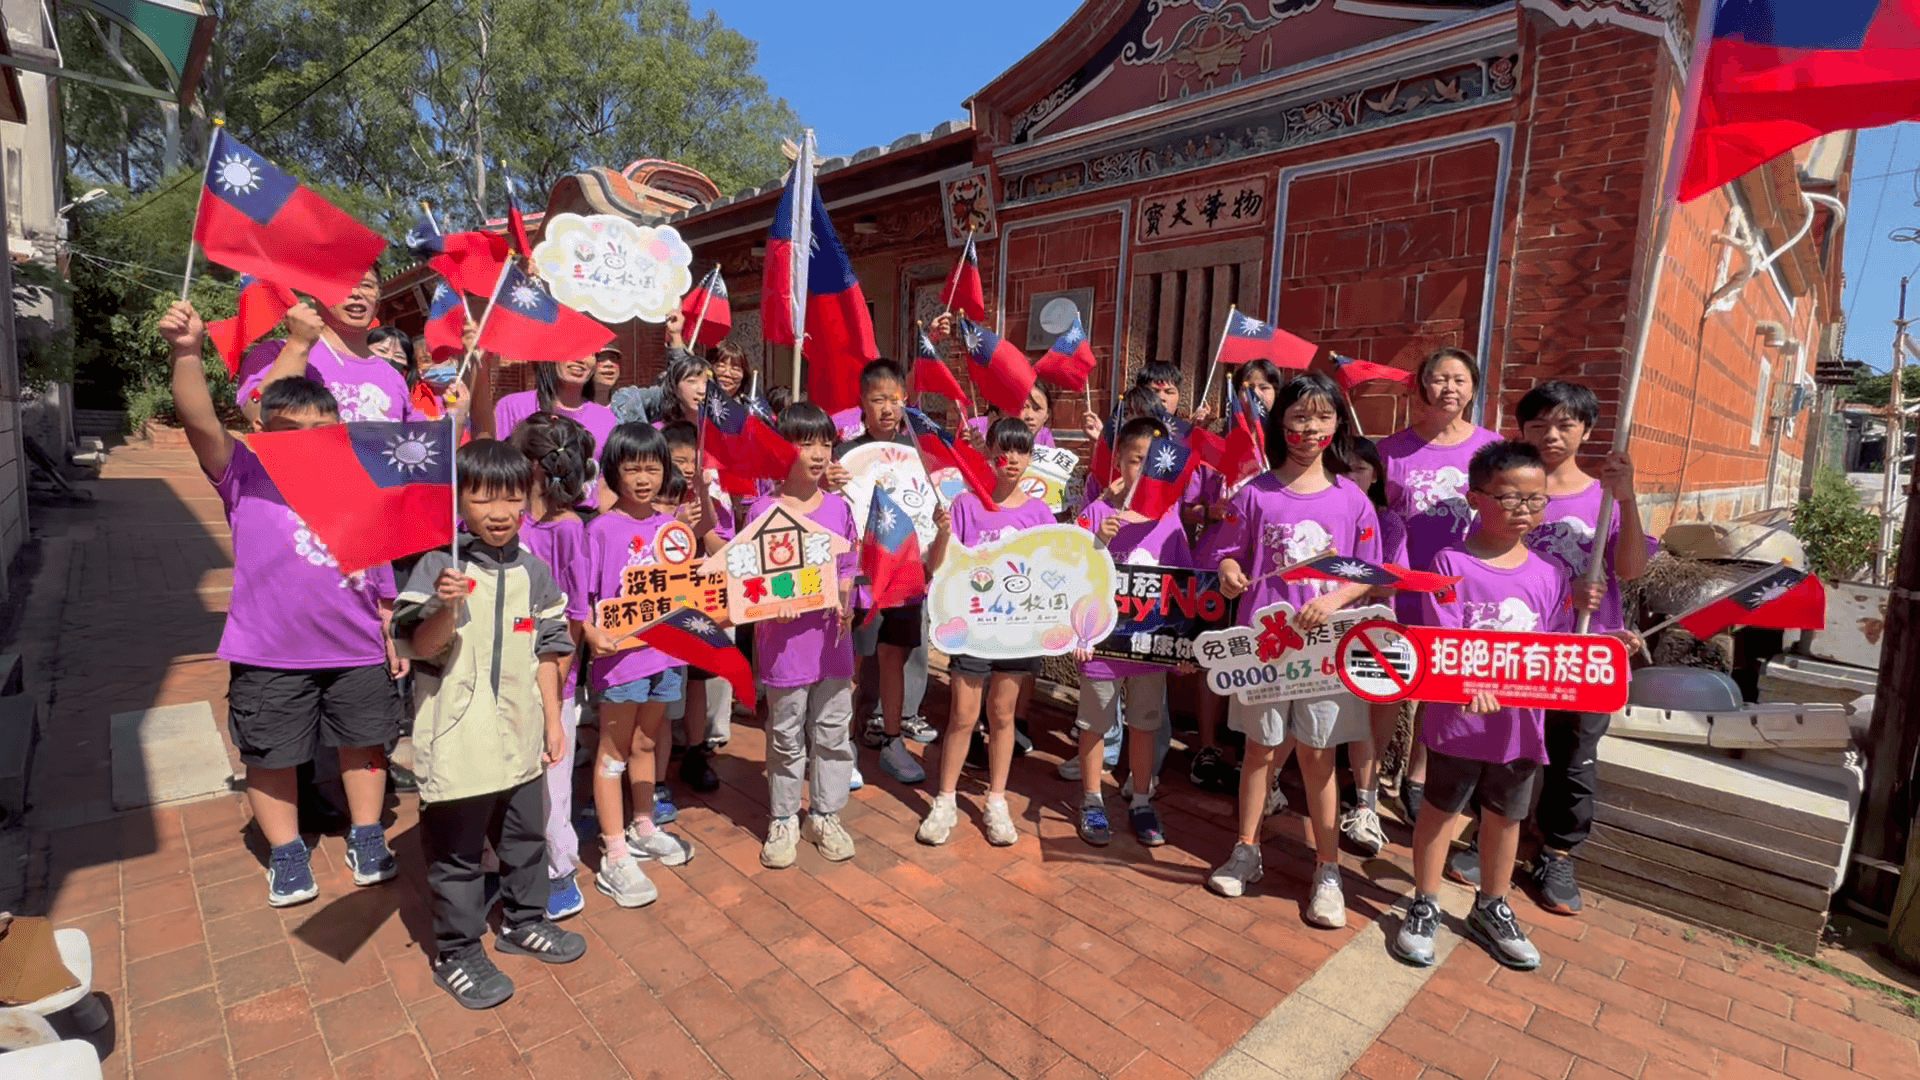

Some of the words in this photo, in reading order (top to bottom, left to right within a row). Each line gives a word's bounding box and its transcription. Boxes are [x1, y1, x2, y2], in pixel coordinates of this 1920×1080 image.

[1160, 574, 1225, 622] No
[1431, 637, 1615, 685] 拒絕所有菸品
